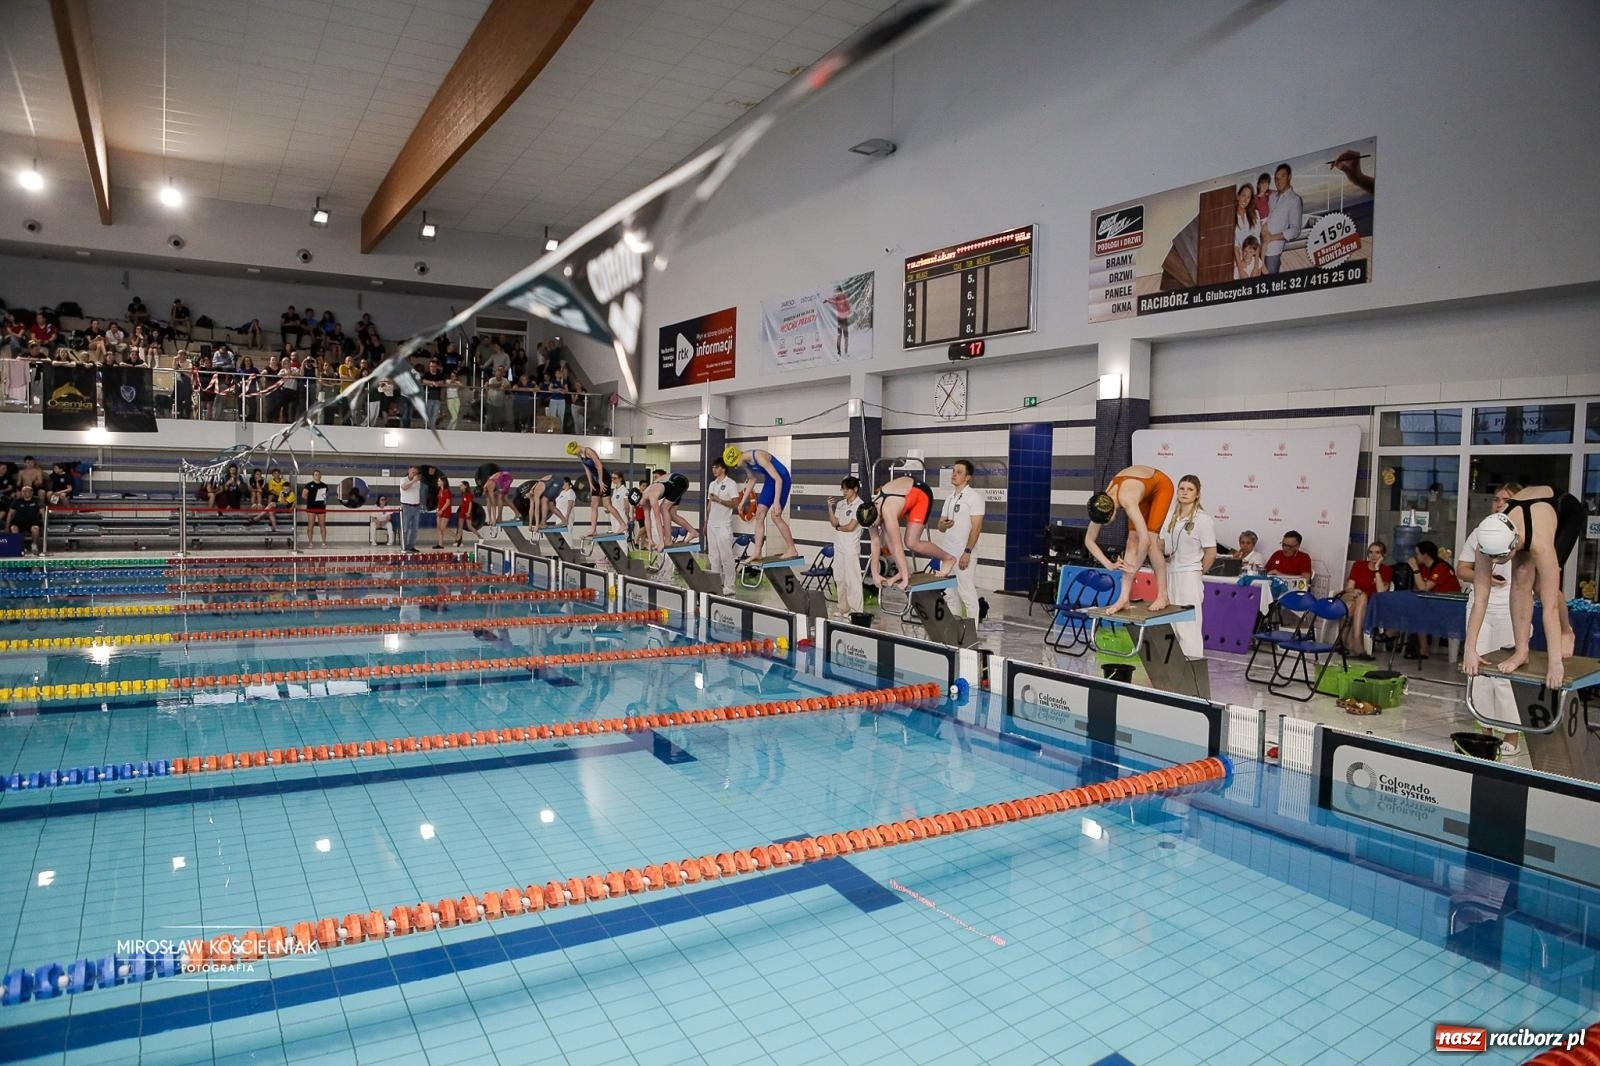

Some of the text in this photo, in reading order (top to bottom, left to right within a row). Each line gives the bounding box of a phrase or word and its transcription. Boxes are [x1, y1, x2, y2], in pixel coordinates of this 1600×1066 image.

[1314, 220, 1351, 244] -15%
[1124, 236, 1142, 245] DRZWI
[1318, 241, 1358, 265] MONTAŻEM
[1106, 254, 1133, 268] BRAMY
[1109, 270, 1132, 283] DRZWI
[1105, 286, 1132, 299] PANELE
[1141, 268, 1360, 311] RACIBÓRZ ul. Głubczycka 13, tel: 32 / 415 25 00
[1112, 301, 1132, 314] OKNA
[696, 335, 733, 357] informacji
[969, 342, 982, 355] 17
[678, 347, 689, 360] rtk
[558, 538, 564, 550] 2
[614, 549, 620, 561] 3
[686, 558, 694, 574] 4
[785, 575, 794, 593] 5
[935, 598, 945, 621] 6
[1164, 634, 1175, 664] 7
[1039, 692, 1067, 705] Colorado
[1568, 698, 1578, 738] 8
[1379, 774, 1430, 794] Colorado
[1380, 784, 1398, 794] TIME
